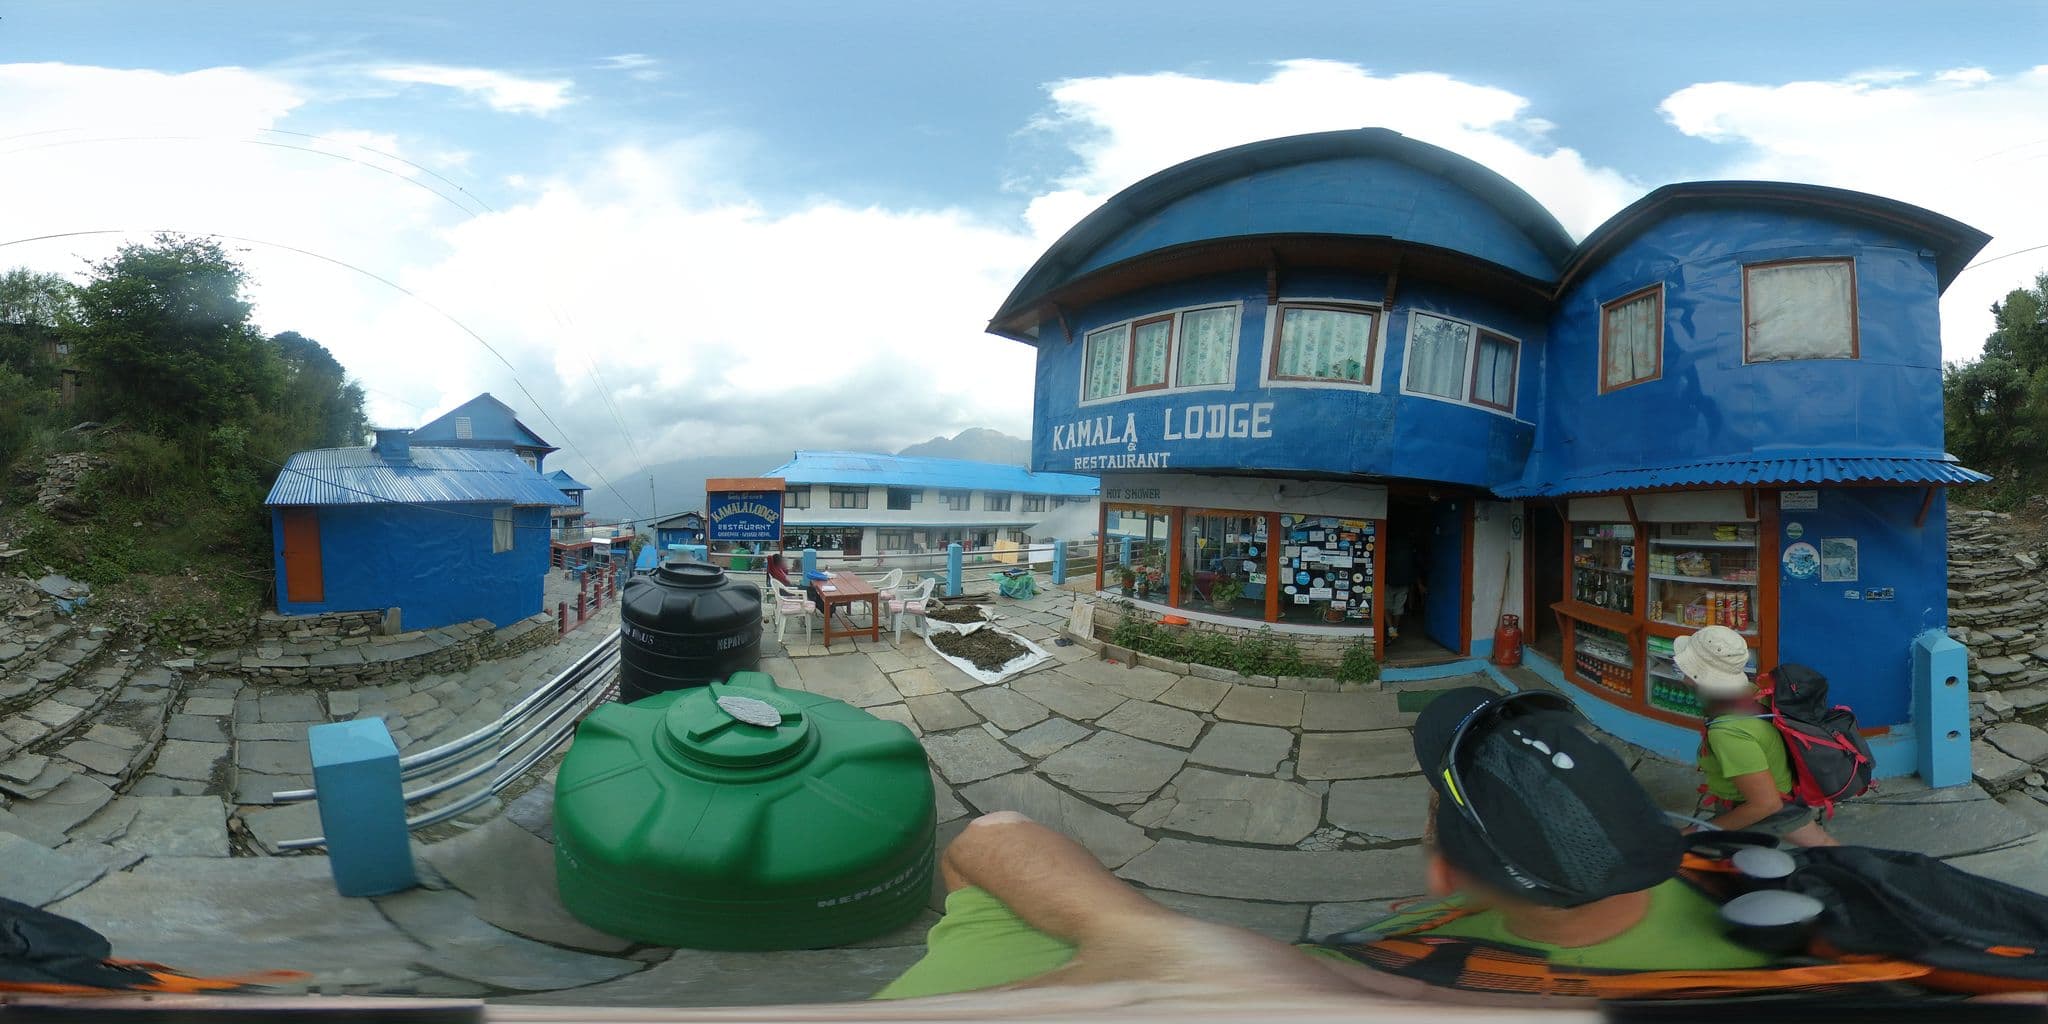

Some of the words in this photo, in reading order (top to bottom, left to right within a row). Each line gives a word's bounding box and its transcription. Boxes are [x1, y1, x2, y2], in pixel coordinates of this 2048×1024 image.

[1053, 412, 1138, 451] KAMALA
[1163, 402, 1275, 440] LODGE
[1127, 442, 1137, 452] &
[1074, 452, 1171, 470] RESTAURANT
[1106, 487, 1123, 499] HOT
[1124, 488, 1161, 499] SHOWER
[711, 502, 748, 523] KAMALA
[749, 502, 779, 523] LODGE
